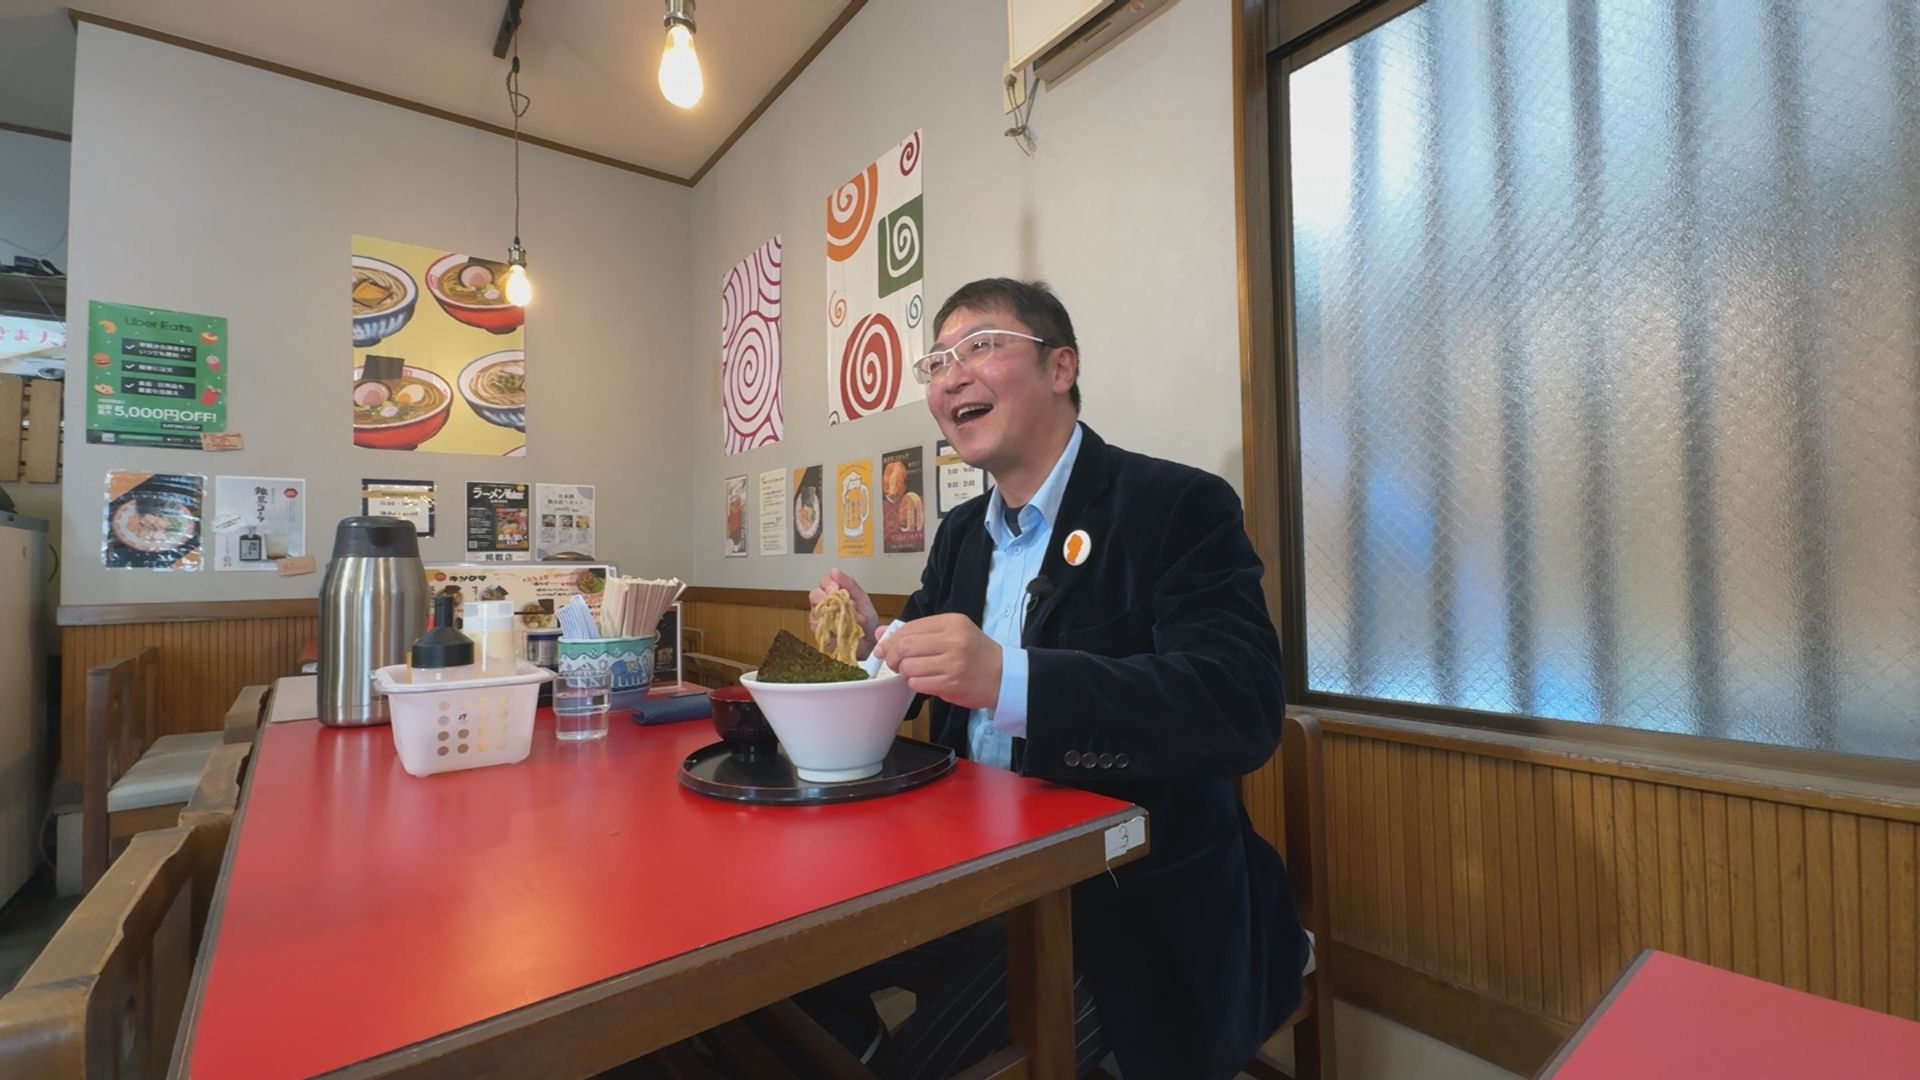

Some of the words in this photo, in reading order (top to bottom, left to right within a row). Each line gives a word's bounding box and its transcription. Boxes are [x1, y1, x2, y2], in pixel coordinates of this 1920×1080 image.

[124, 316, 158, 330] Uber
[160, 321, 194, 334] Eats
[114, 405, 217, 423] 5,000円OFF!
